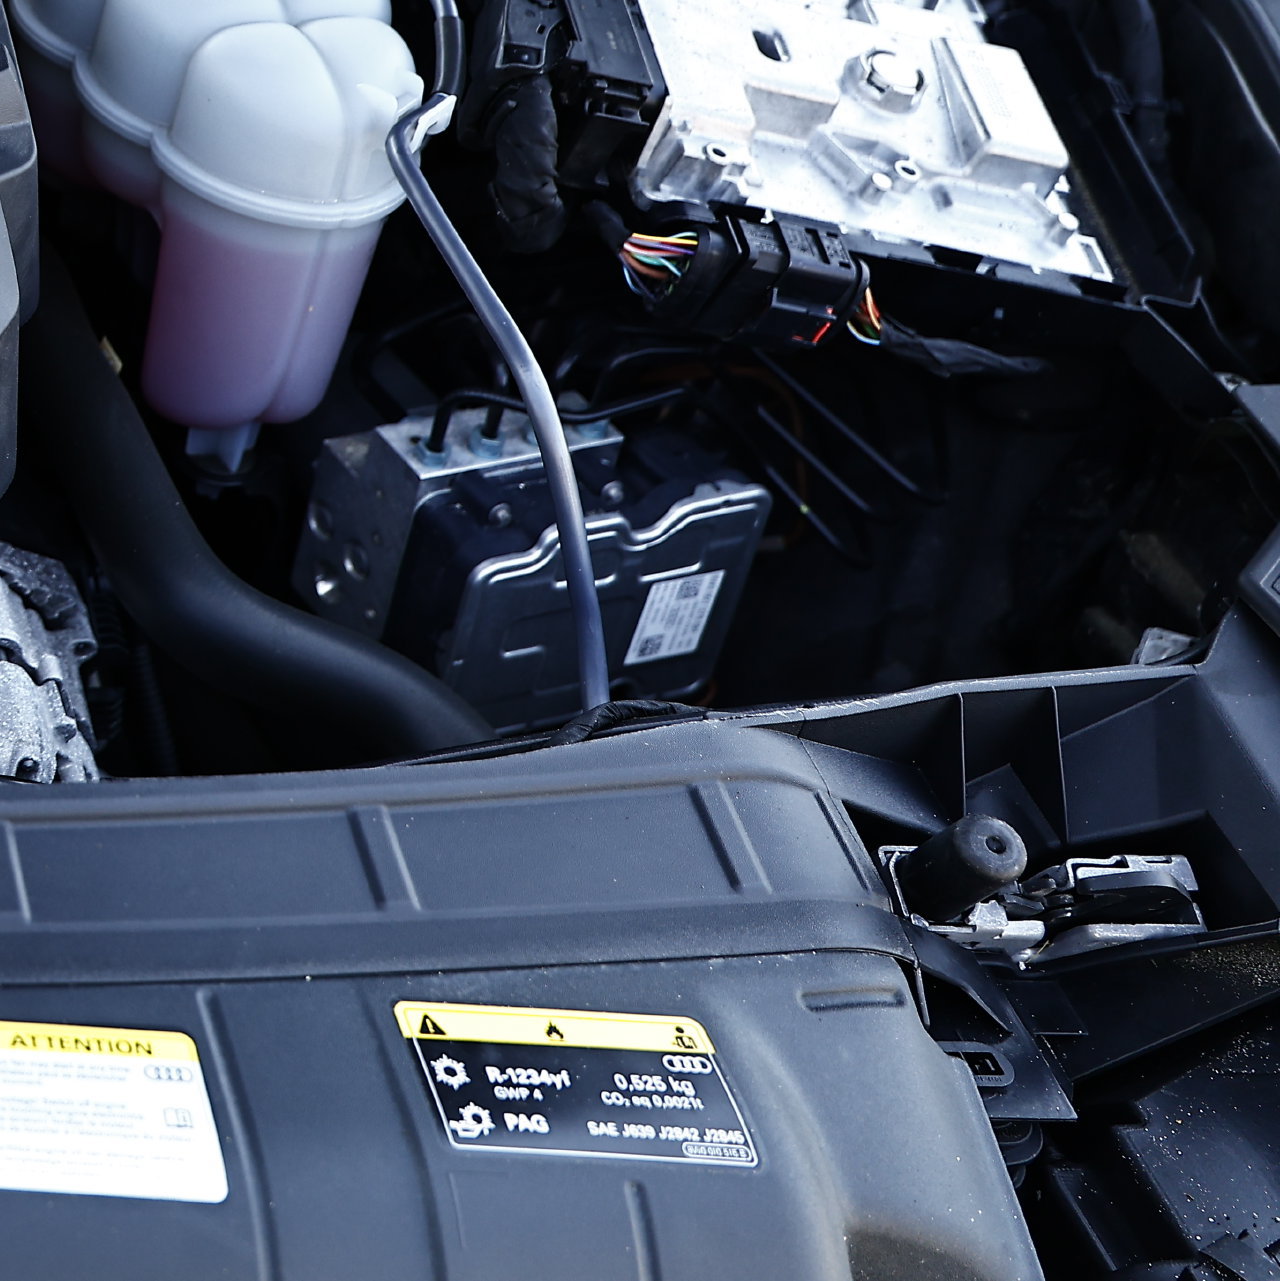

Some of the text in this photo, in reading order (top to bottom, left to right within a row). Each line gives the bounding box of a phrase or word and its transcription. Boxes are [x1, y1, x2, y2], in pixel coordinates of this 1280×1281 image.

[11, 1032, 154, 1056] ATTENTION
[484, 1064, 572, 1090] R-1234yf
[613, 1072, 696, 1097] 0,525 kg
[493, 1085, 544, 1102] GWP 4
[631, 1096, 653, 1110] eq
[503, 1112, 551, 1135] PAG
[586, 1120, 745, 1144] SAE J639 J2842 J2845
